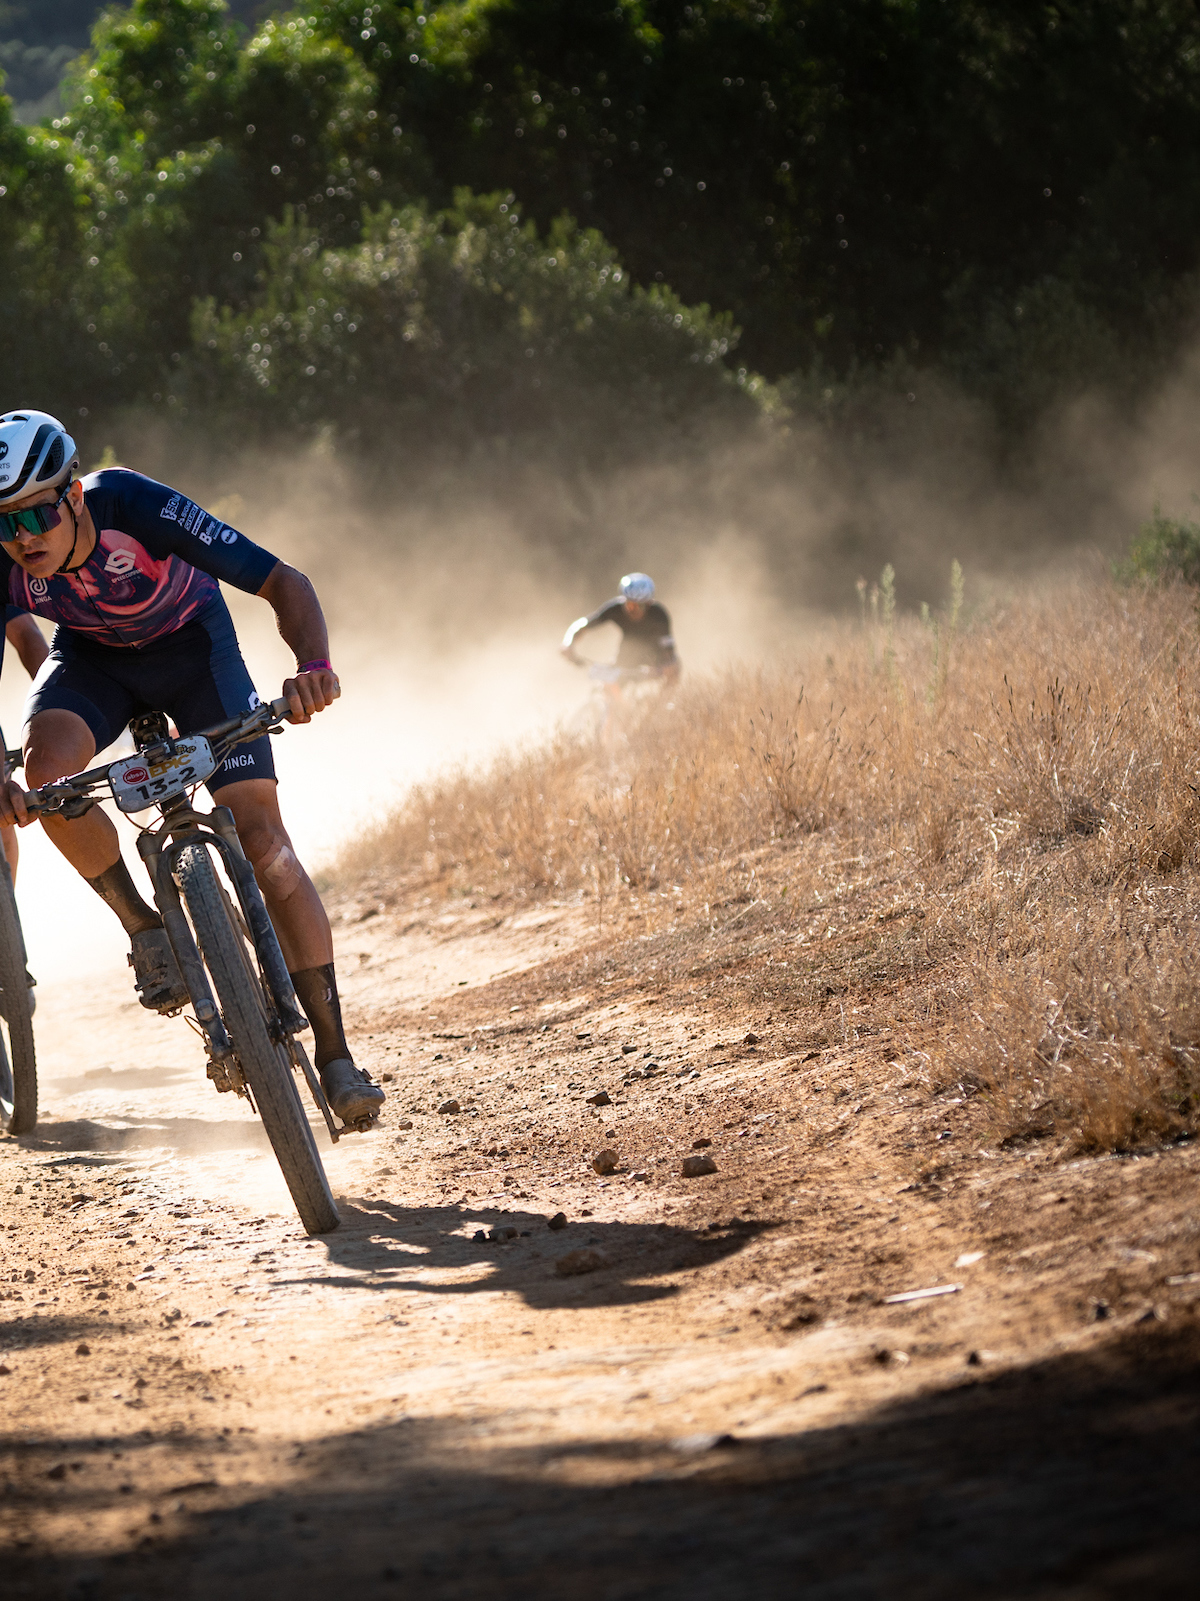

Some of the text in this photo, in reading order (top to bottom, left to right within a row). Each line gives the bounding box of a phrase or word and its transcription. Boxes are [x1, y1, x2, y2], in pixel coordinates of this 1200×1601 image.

[148, 754, 192, 779] EPIC
[223, 753, 256, 772] JINGA
[135, 766, 197, 800] 13-2
